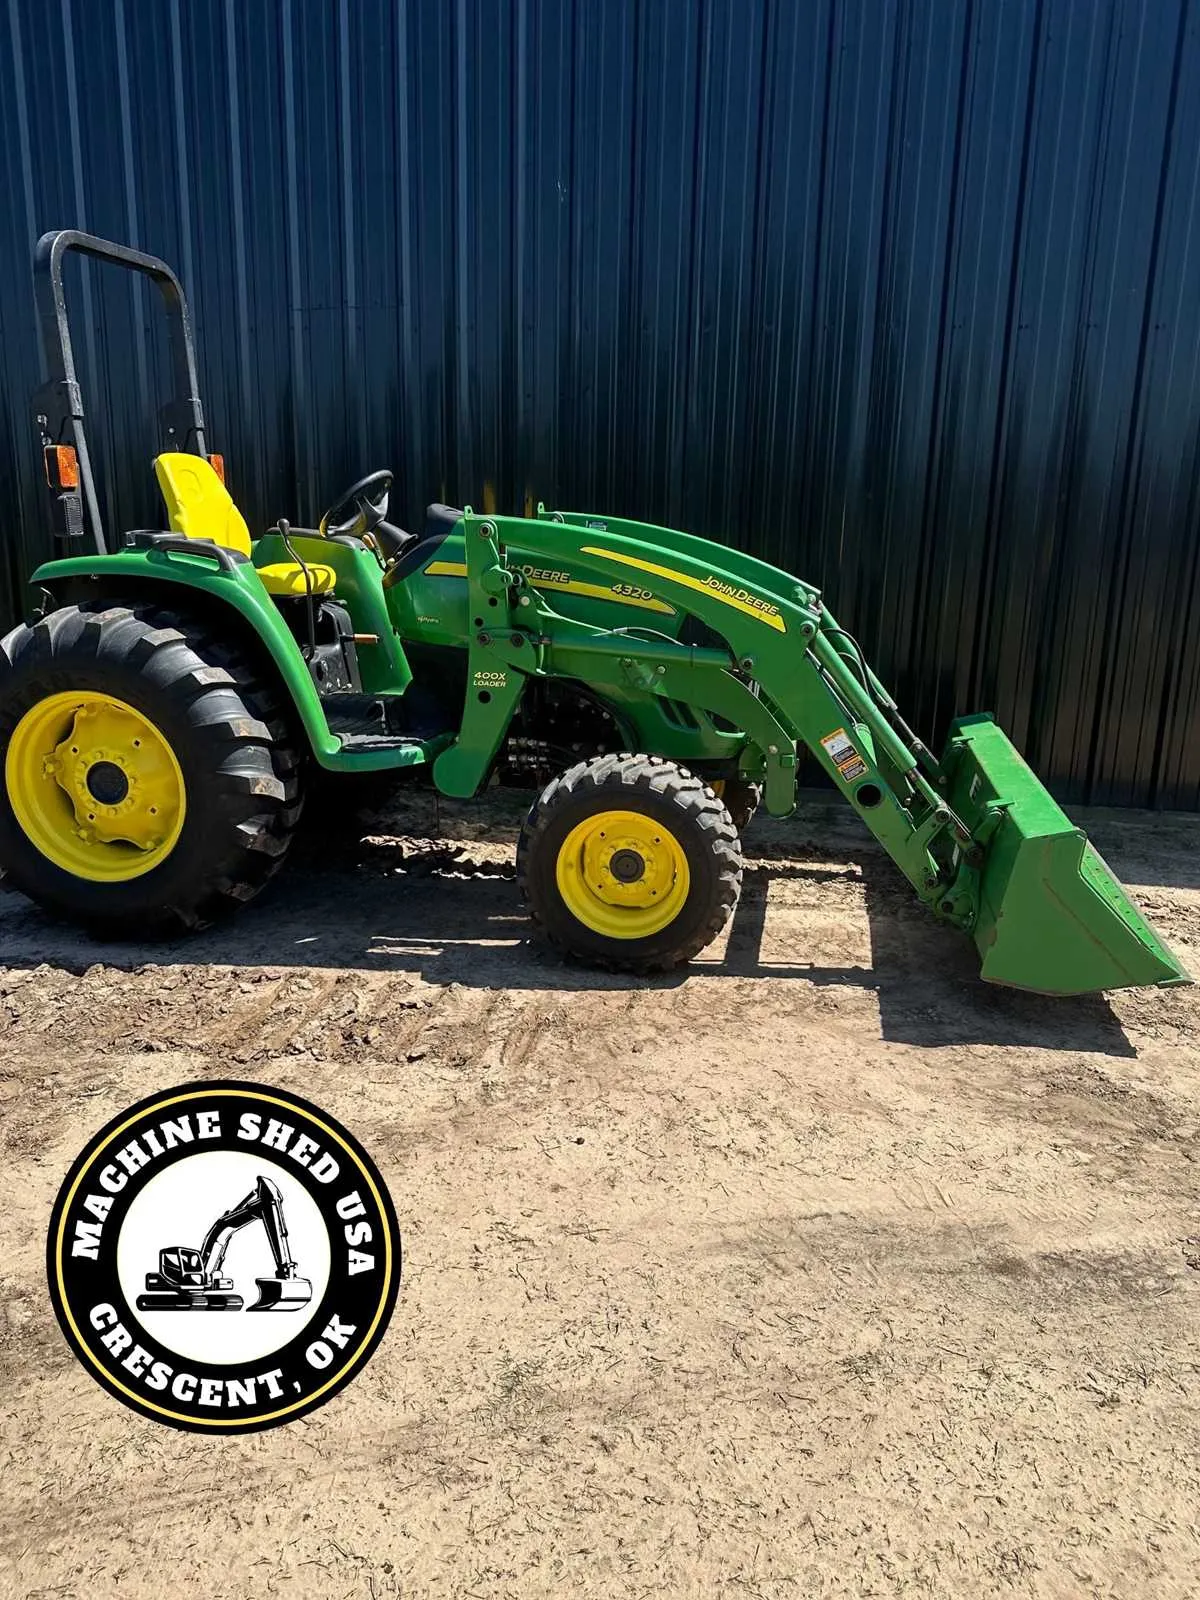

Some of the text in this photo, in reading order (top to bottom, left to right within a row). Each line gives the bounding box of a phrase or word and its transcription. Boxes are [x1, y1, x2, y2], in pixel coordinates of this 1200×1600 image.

[522, 564, 570, 583] DEERE
[611, 583, 653, 600] 4320
[701, 575, 779, 616] JOHN DEERE
[473, 680, 506, 688] LOADER
[474, 671, 506, 680] 400X
